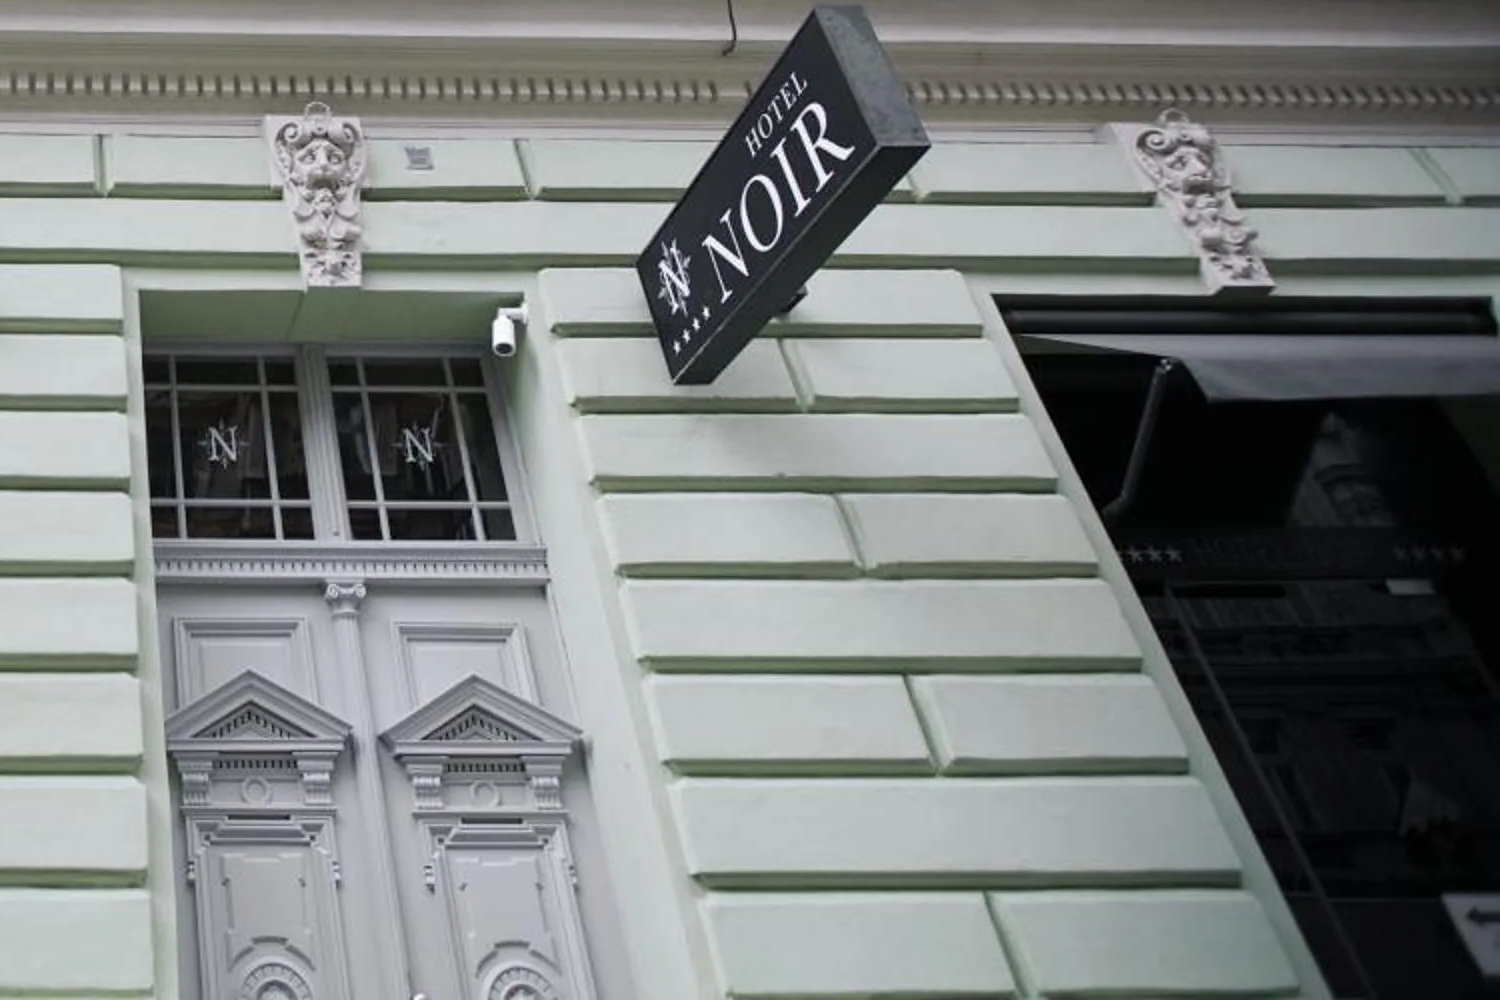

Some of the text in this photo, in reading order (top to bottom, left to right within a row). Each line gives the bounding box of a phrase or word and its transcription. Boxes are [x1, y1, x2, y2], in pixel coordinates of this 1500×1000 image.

[744, 71, 809, 158] HOTEL
[702, 101, 856, 304] NOIR
[658, 246, 691, 315] N
[208, 425, 239, 462] N
[403, 427, 435, 463] N
